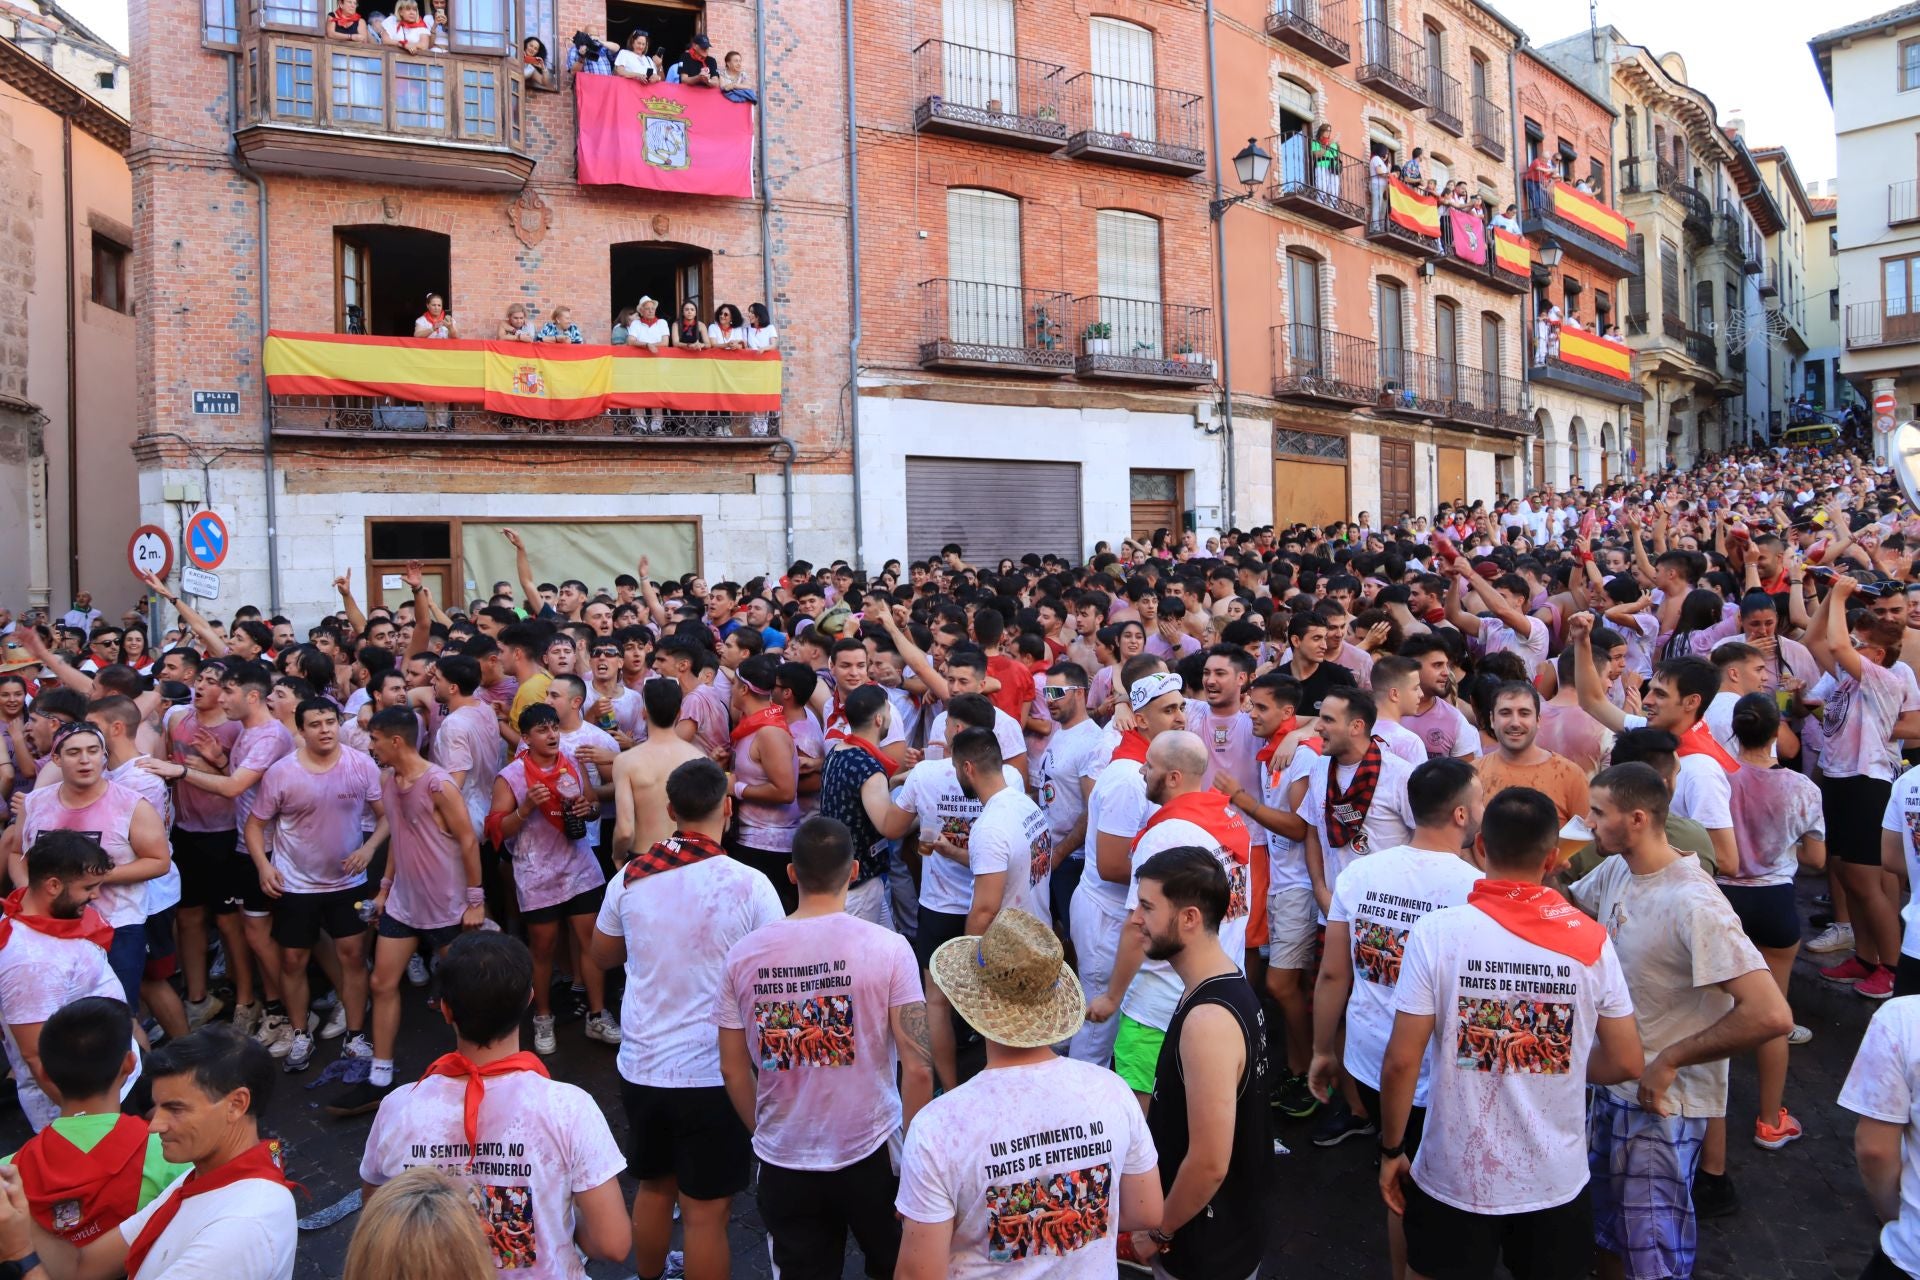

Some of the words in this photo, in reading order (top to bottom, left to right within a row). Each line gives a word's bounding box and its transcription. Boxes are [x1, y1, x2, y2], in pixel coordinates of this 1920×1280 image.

[203, 402, 236, 413] MAYOR
[139, 545, 146, 560] 2
[941, 794, 950, 802] UN
[1910, 786, 1919, 794] UN
[937, 803, 958, 812] TRATES
[959, 805, 968, 813] DE
[1366, 890, 1378, 901] UN
[1357, 903, 1386, 918] TRATES
[1387, 909, 1399, 920] DE
[758, 967, 770, 979] UN
[772, 961, 832, 979] SENTIMIENTO,
[833, 959, 846, 971] NO
[1467, 959, 1482, 972] UN
[1485, 960, 1554, 979] SENTIMIENTO,
[1556, 965, 1571, 978] NO
[753, 982, 784, 995] TRATES
[786, 981, 798, 993] DE
[800, 975, 852, 993] ENTENDERLO
[1459, 975, 1496, 991] TRATES
[1499, 979, 1512, 991] DE
[1514, 980, 1577, 996] ENTENDERLO
[990, 1142, 1008, 1157] UN
[1010, 1125, 1088, 1154] SENTIMIENTO,
[1089, 1120, 1104, 1136] NO
[411, 1144, 427, 1158] UN
[508, 1143, 525, 1157] NO
[984, 1157, 1026, 1180] TRATES
[1028, 1153, 1043, 1169] DE
[1045, 1139, 1112, 1165] ENTENDERLO
